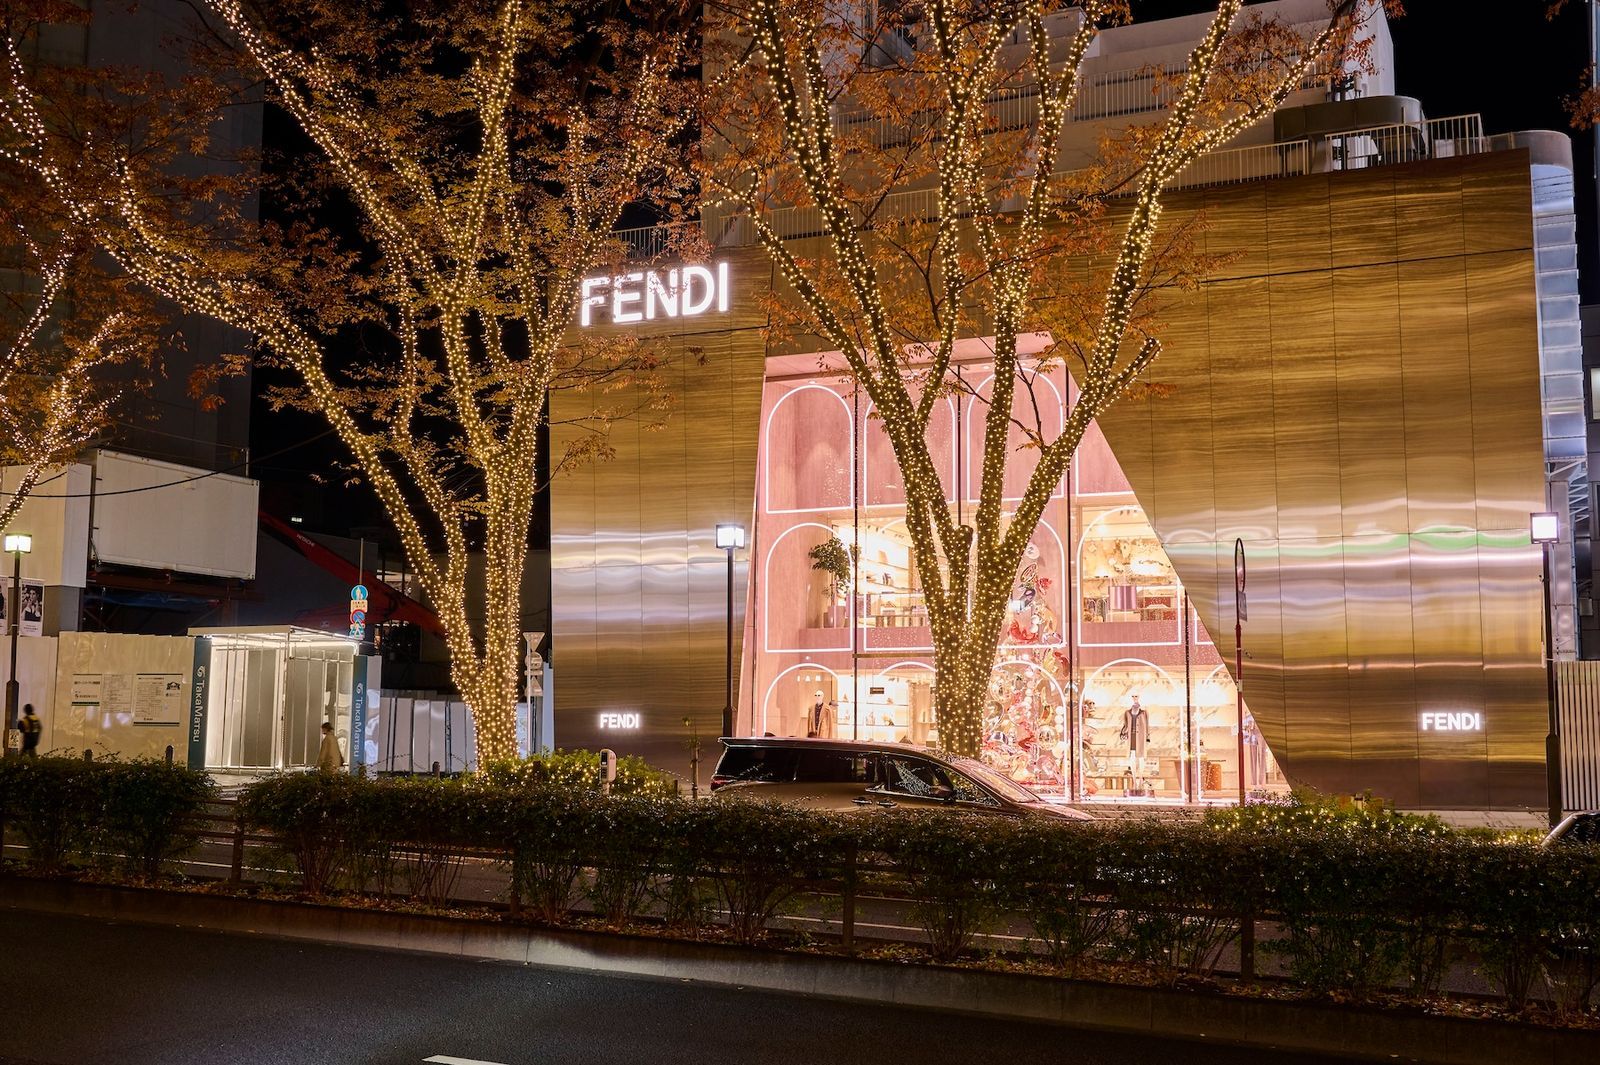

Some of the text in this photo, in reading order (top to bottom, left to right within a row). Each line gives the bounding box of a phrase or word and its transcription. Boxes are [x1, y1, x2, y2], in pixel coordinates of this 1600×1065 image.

[581, 262, 728, 326] FENDI
[600, 713, 639, 729] FENDI
[1422, 712, 1480, 730] FENDI
